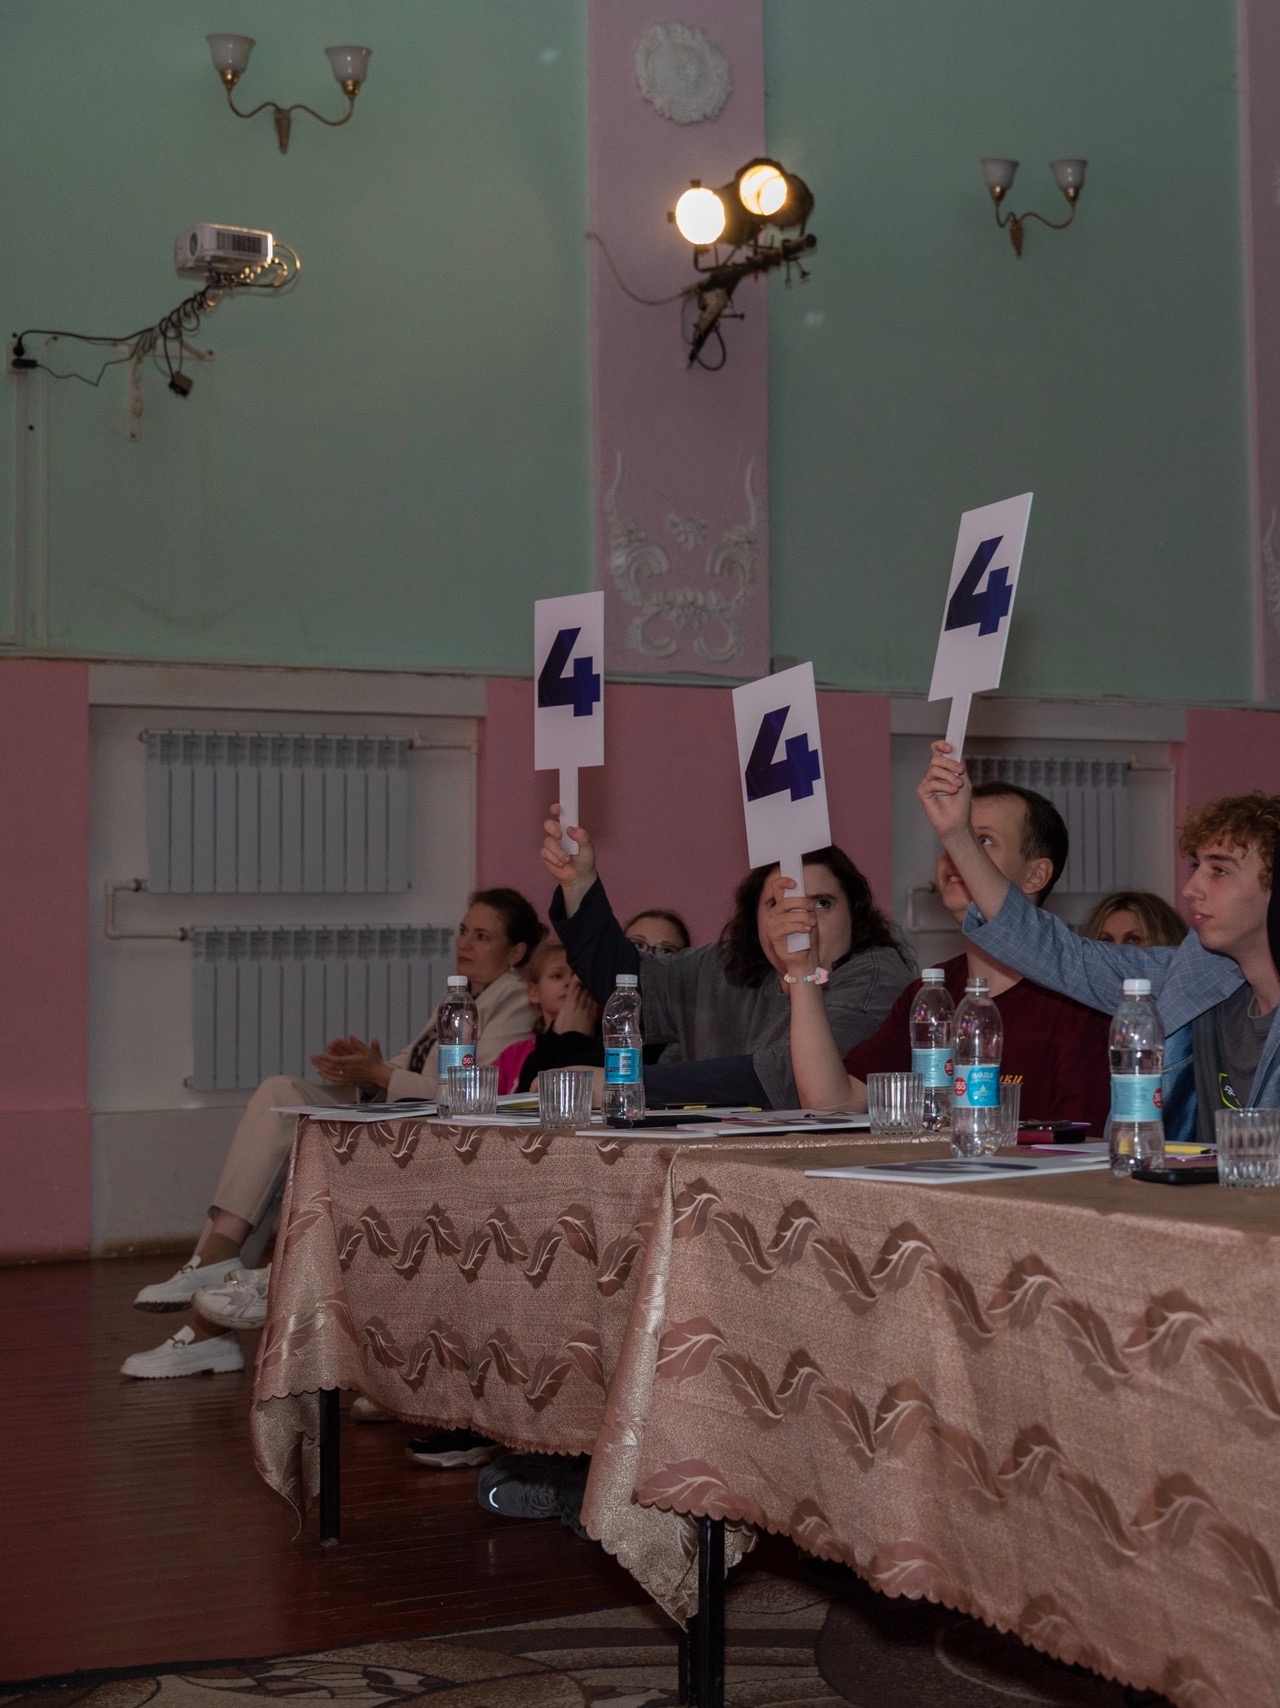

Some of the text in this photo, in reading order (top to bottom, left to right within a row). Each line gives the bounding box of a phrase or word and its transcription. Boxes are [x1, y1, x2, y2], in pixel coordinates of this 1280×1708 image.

[944, 534, 1013, 637] 4
[537, 626, 601, 717] 4
[745, 704, 821, 803] 4
[954, 1081, 967, 1090] 365
